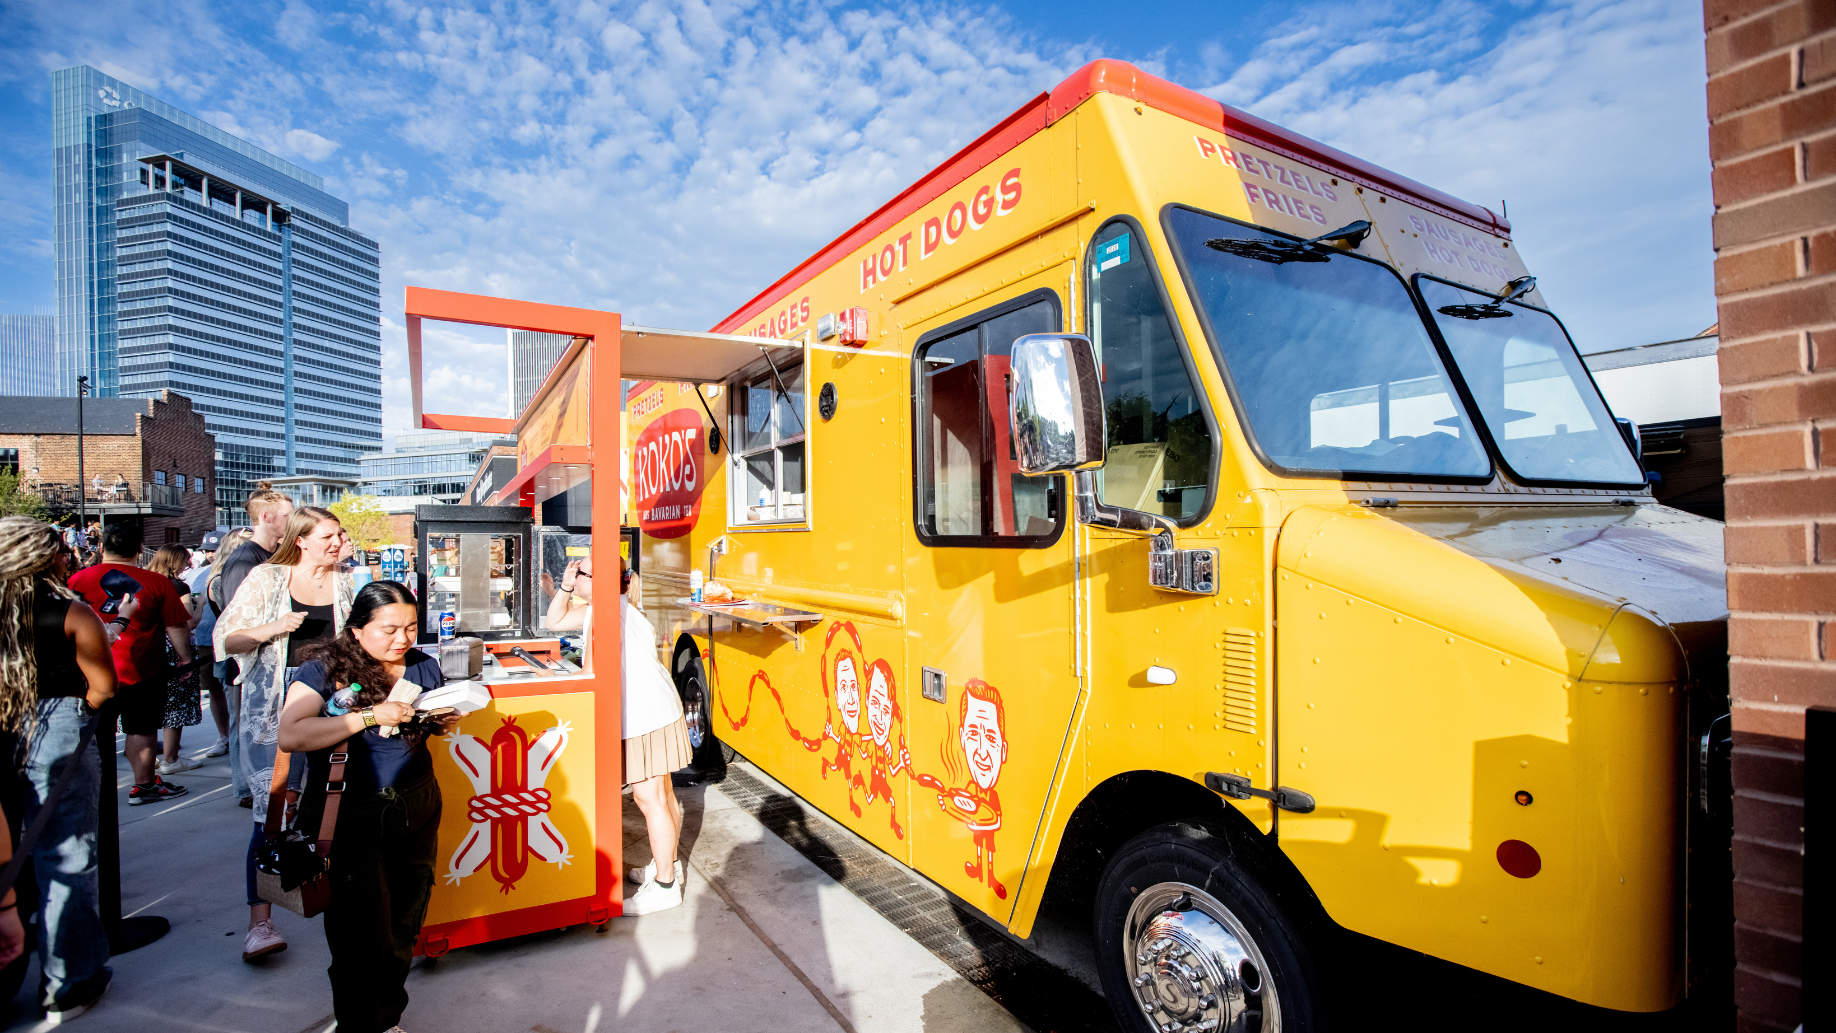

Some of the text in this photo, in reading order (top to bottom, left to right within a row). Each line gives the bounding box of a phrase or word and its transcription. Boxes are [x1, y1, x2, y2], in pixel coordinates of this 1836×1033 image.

[1193, 136, 1338, 202] PRETZELS
[1241, 181, 1327, 226] FRIES
[860, 168, 1023, 294] HOT DOGS
[1407, 214, 1507, 261] SAUSAGES
[1421, 240, 1516, 282] HOT DOGS
[632, 388, 664, 421] PRETZELS
[639, 428, 697, 501] KOKO'S
[651, 505, 681, 521] BAVARIAN
[1148, 854, 1174, 864] Conti
